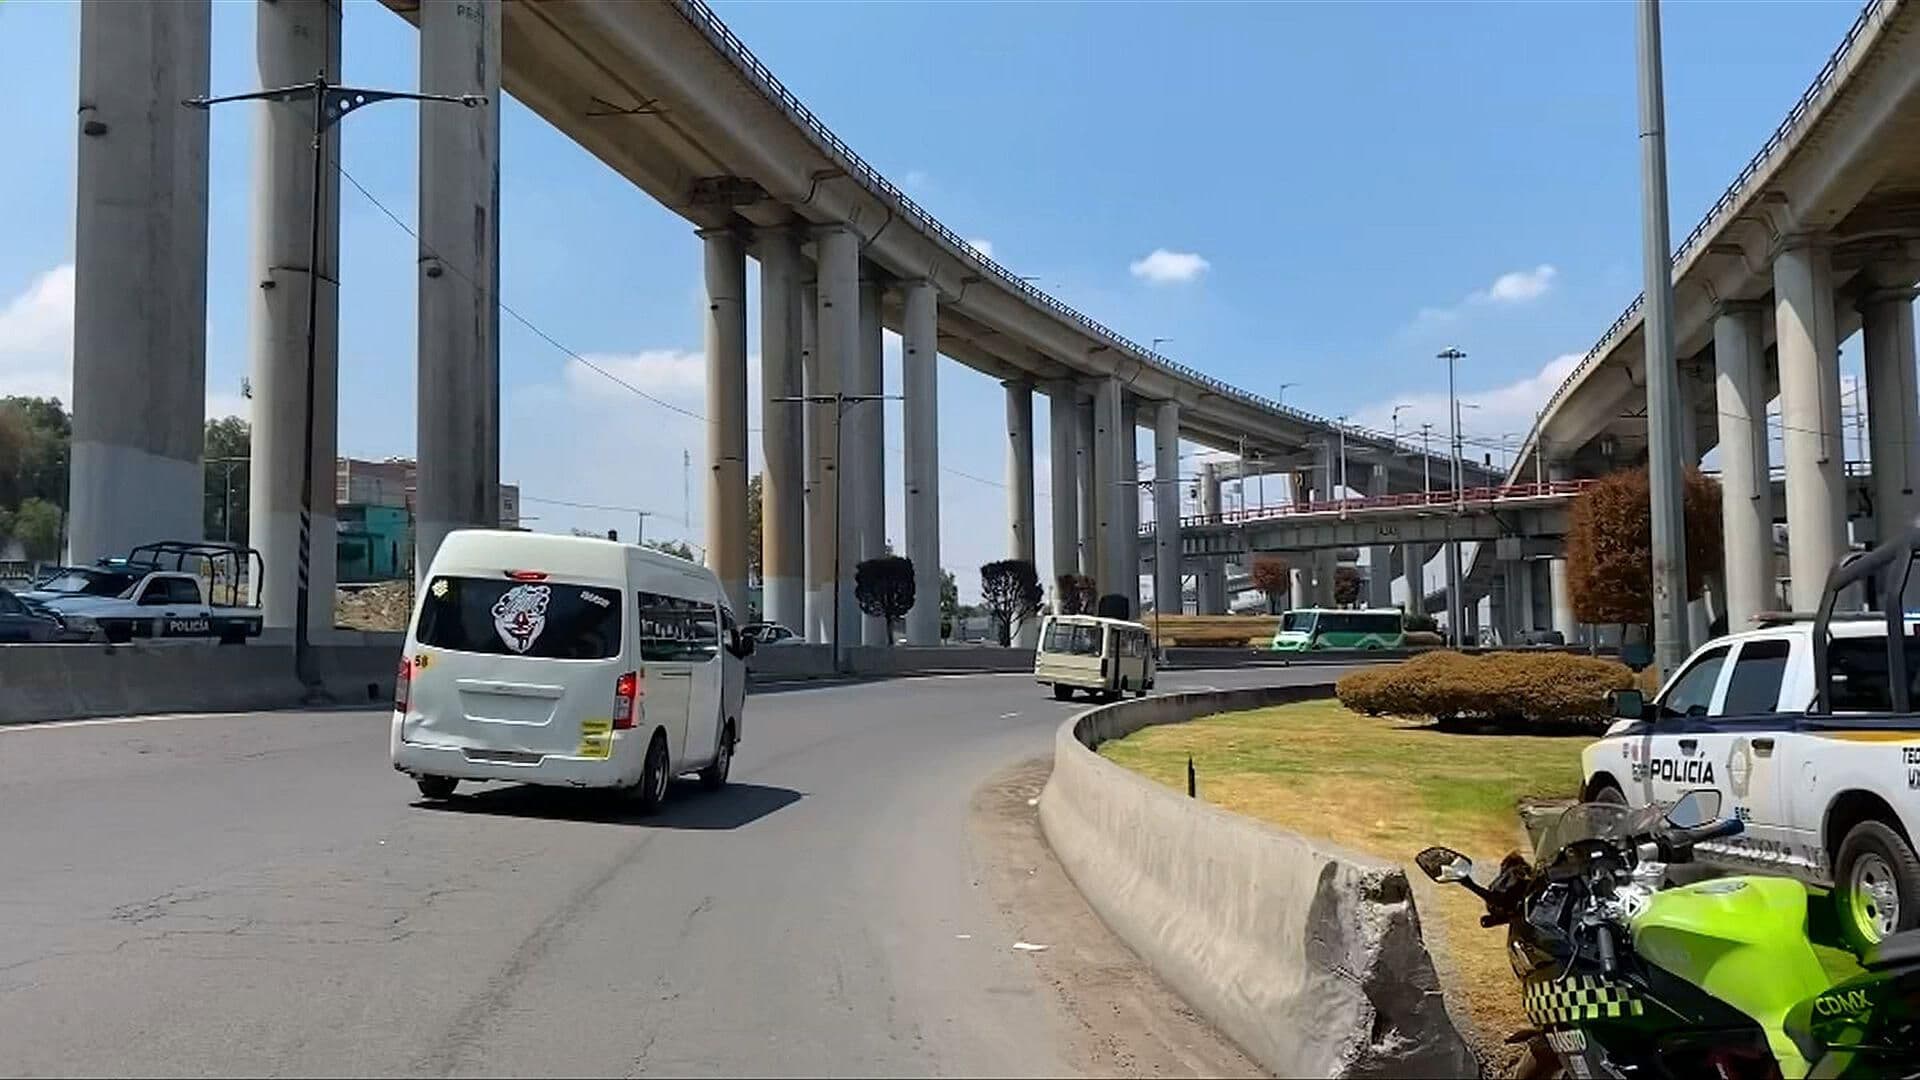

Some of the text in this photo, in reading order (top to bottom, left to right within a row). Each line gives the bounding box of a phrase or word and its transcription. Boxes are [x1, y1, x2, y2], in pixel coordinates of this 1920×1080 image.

[170, 619, 210, 632] POLICÍA
[1651, 751, 1715, 785] POLICÍA
[1815, 989, 1874, 1016] CDMX
